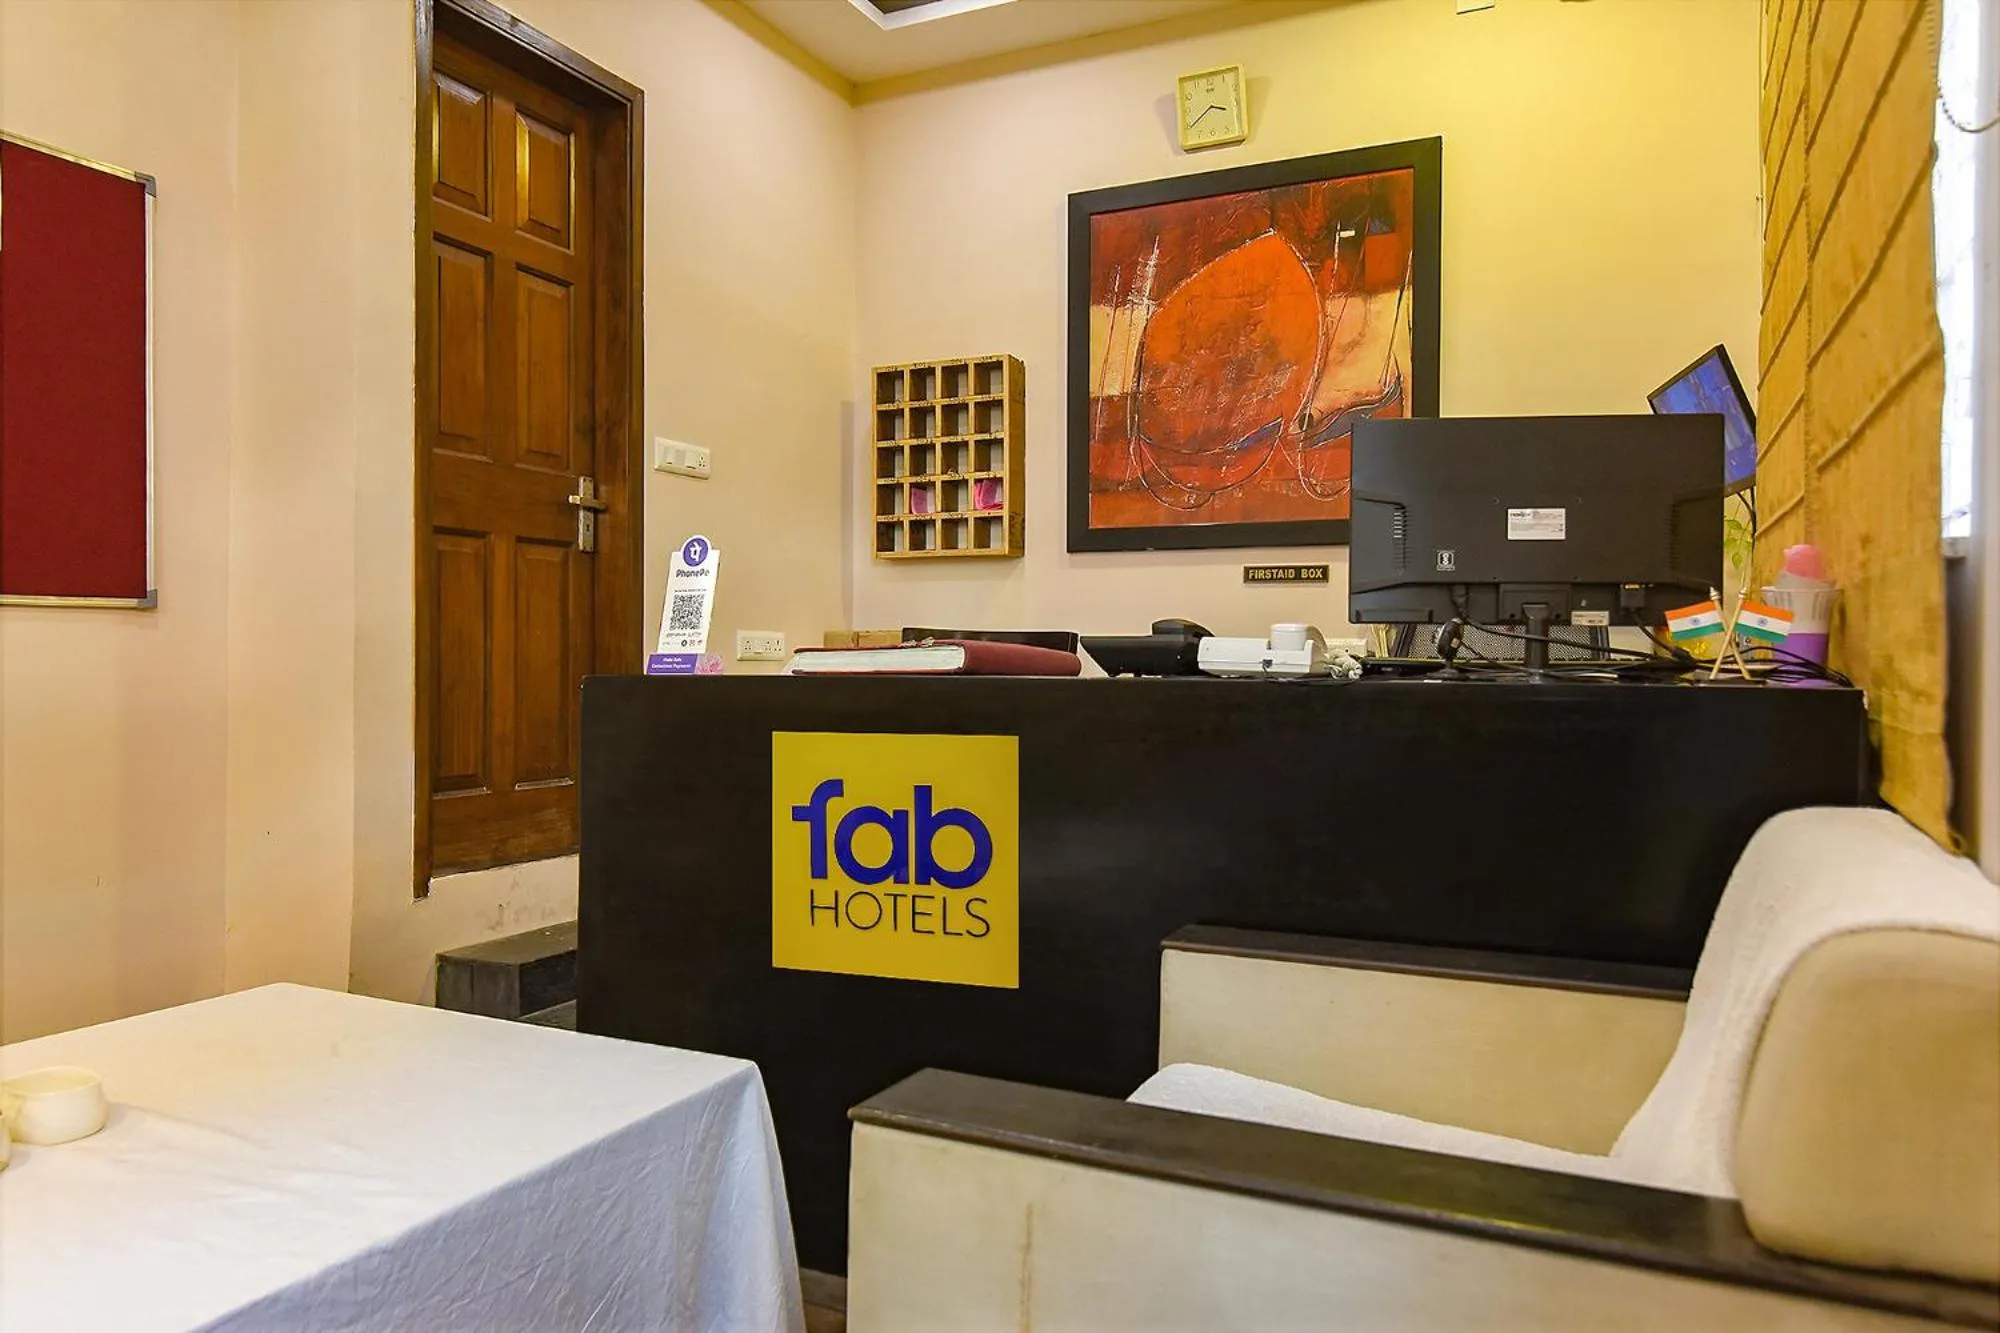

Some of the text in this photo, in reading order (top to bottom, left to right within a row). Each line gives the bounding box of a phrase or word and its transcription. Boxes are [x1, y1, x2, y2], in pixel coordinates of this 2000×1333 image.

[1248, 568, 1323, 579] FIRSTAID BOX
[791, 778, 993, 890] fab
[810, 889, 990, 938] HOTELS
